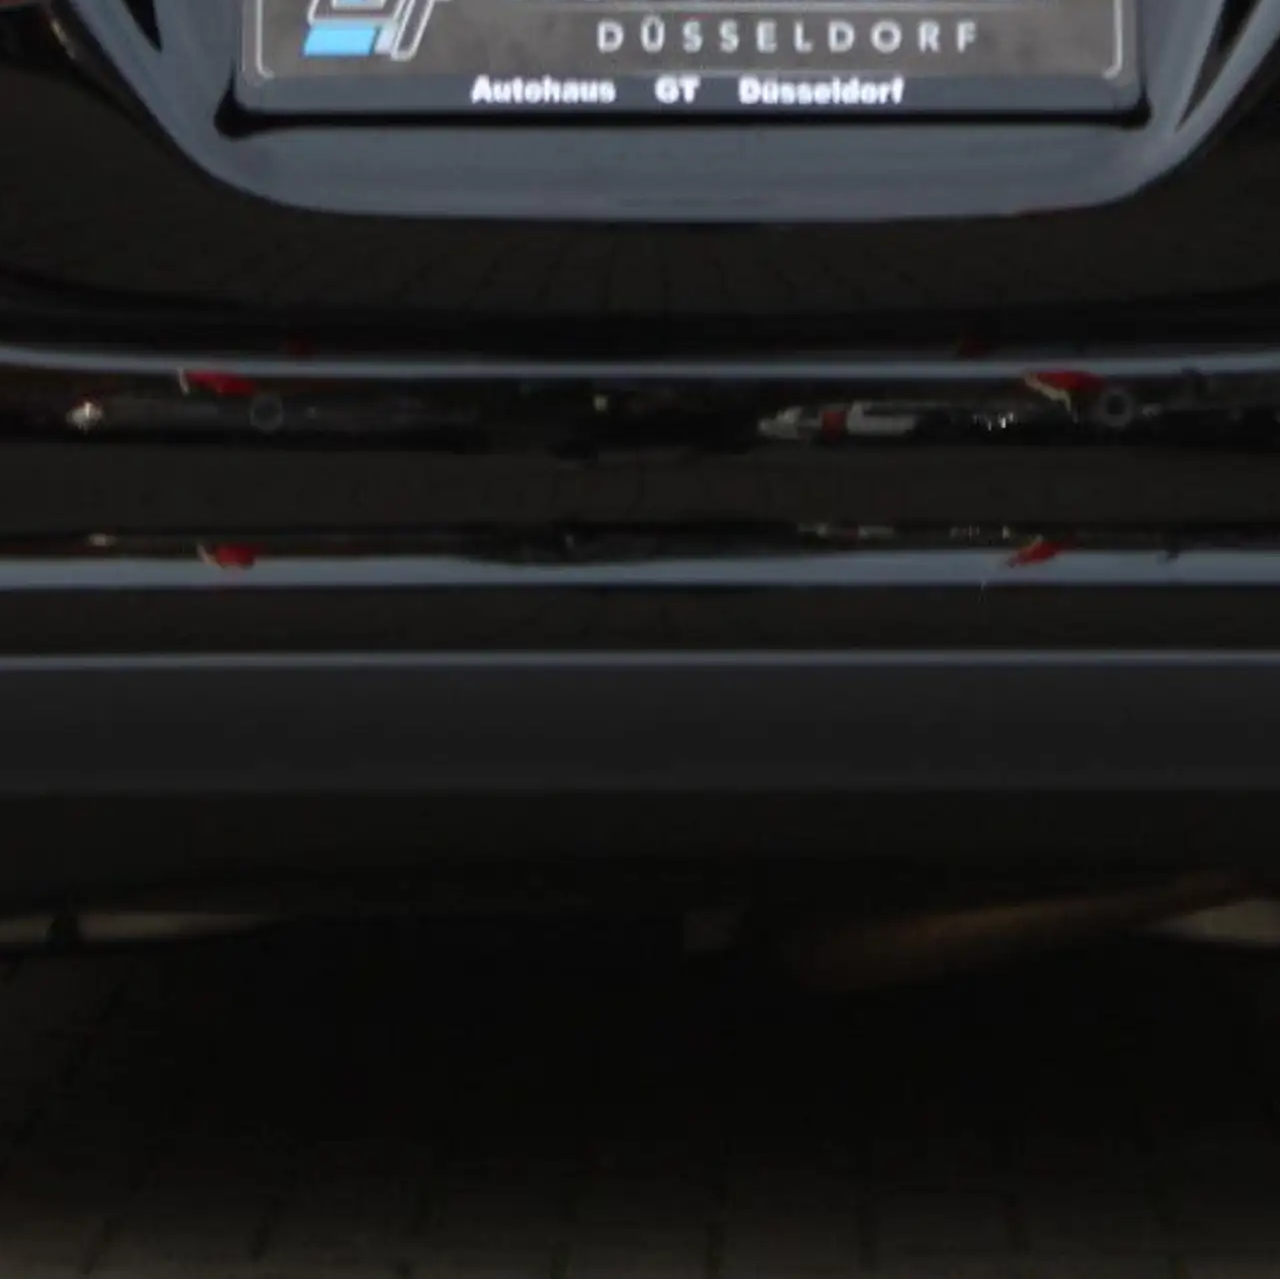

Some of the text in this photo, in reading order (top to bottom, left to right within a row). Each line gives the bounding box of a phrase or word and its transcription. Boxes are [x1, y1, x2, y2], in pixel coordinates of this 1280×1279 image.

[598, 12, 980, 55] DÜSSELDORF
[470, 74, 906, 105] Autohaus GT Düsseldorf
